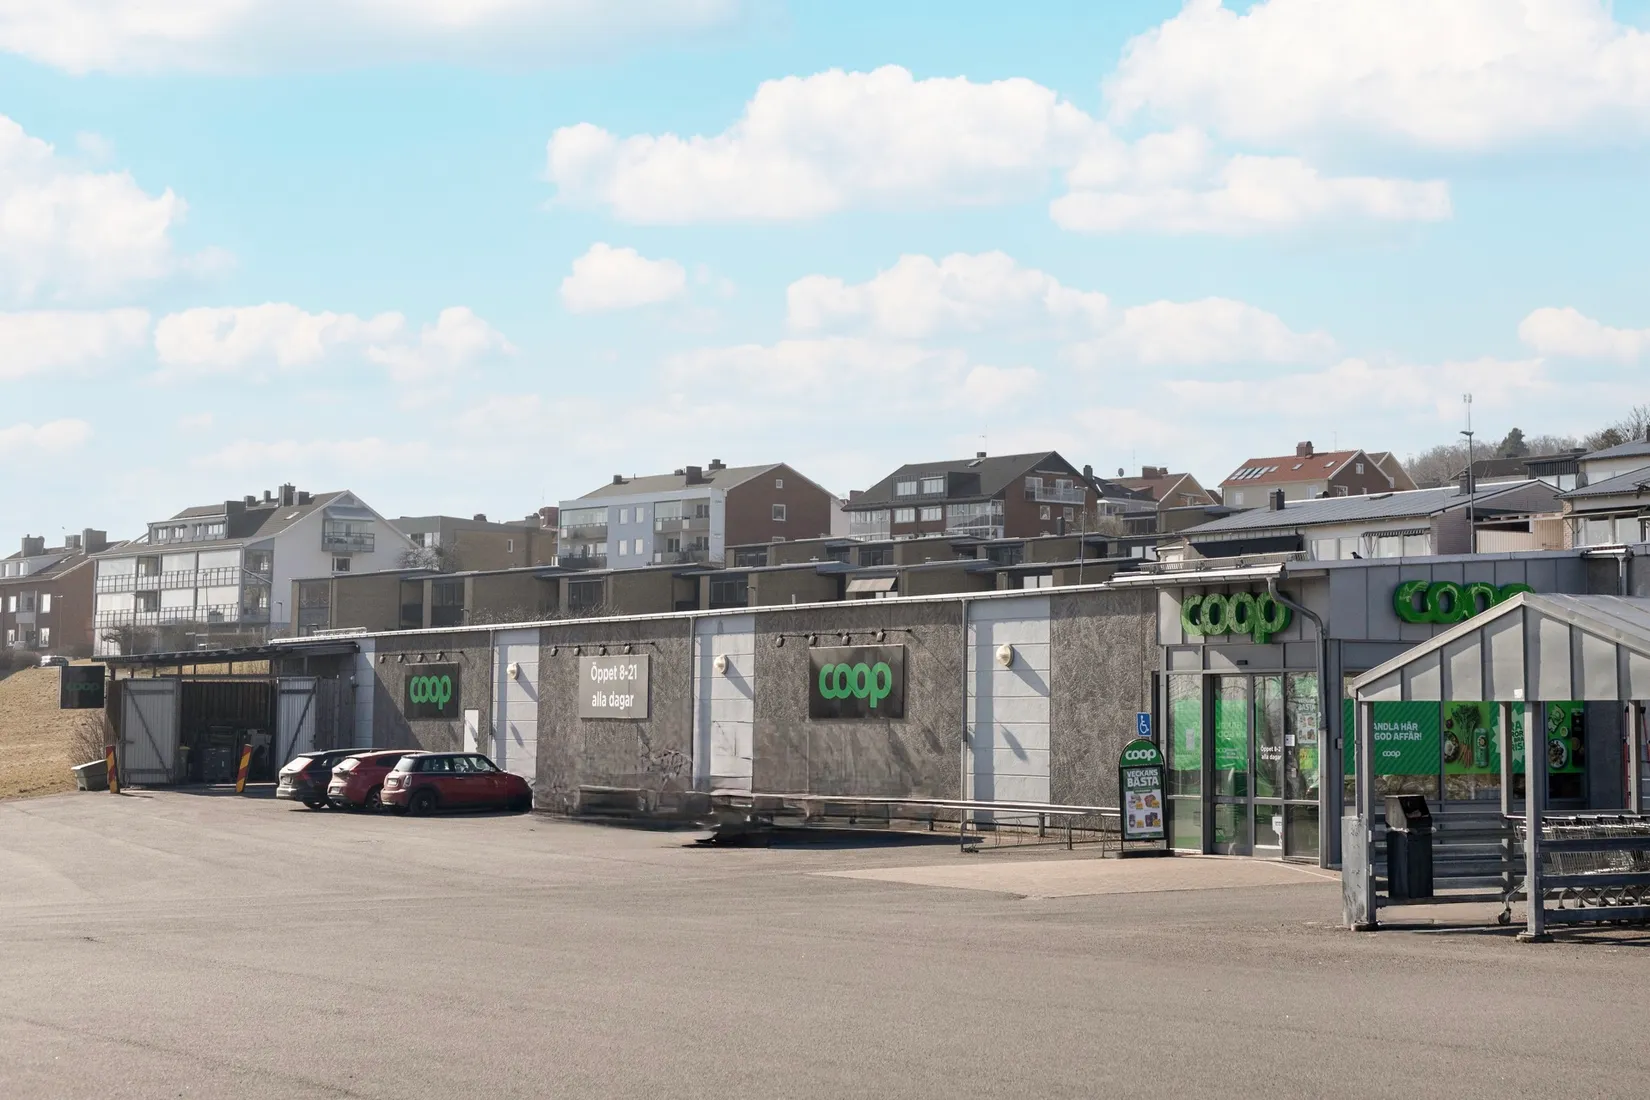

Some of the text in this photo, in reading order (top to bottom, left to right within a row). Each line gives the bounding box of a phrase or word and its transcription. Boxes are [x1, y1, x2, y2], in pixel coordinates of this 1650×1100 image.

[1181, 591, 1290, 643] coop
[591, 662, 637, 684] Öppet 8-21
[410, 675, 451, 709] coop
[819, 662, 892, 708] coop
[592, 691, 634, 710] alla dagar
[1374, 721, 1418, 731] ANDLA HÄR
[1374, 731, 1422, 740] GOD AFFÄR!
[1125, 748, 1157, 761] coop
[1126, 769, 1158, 777] VECKANS
[1127, 776, 1159, 788] BÄSTA
